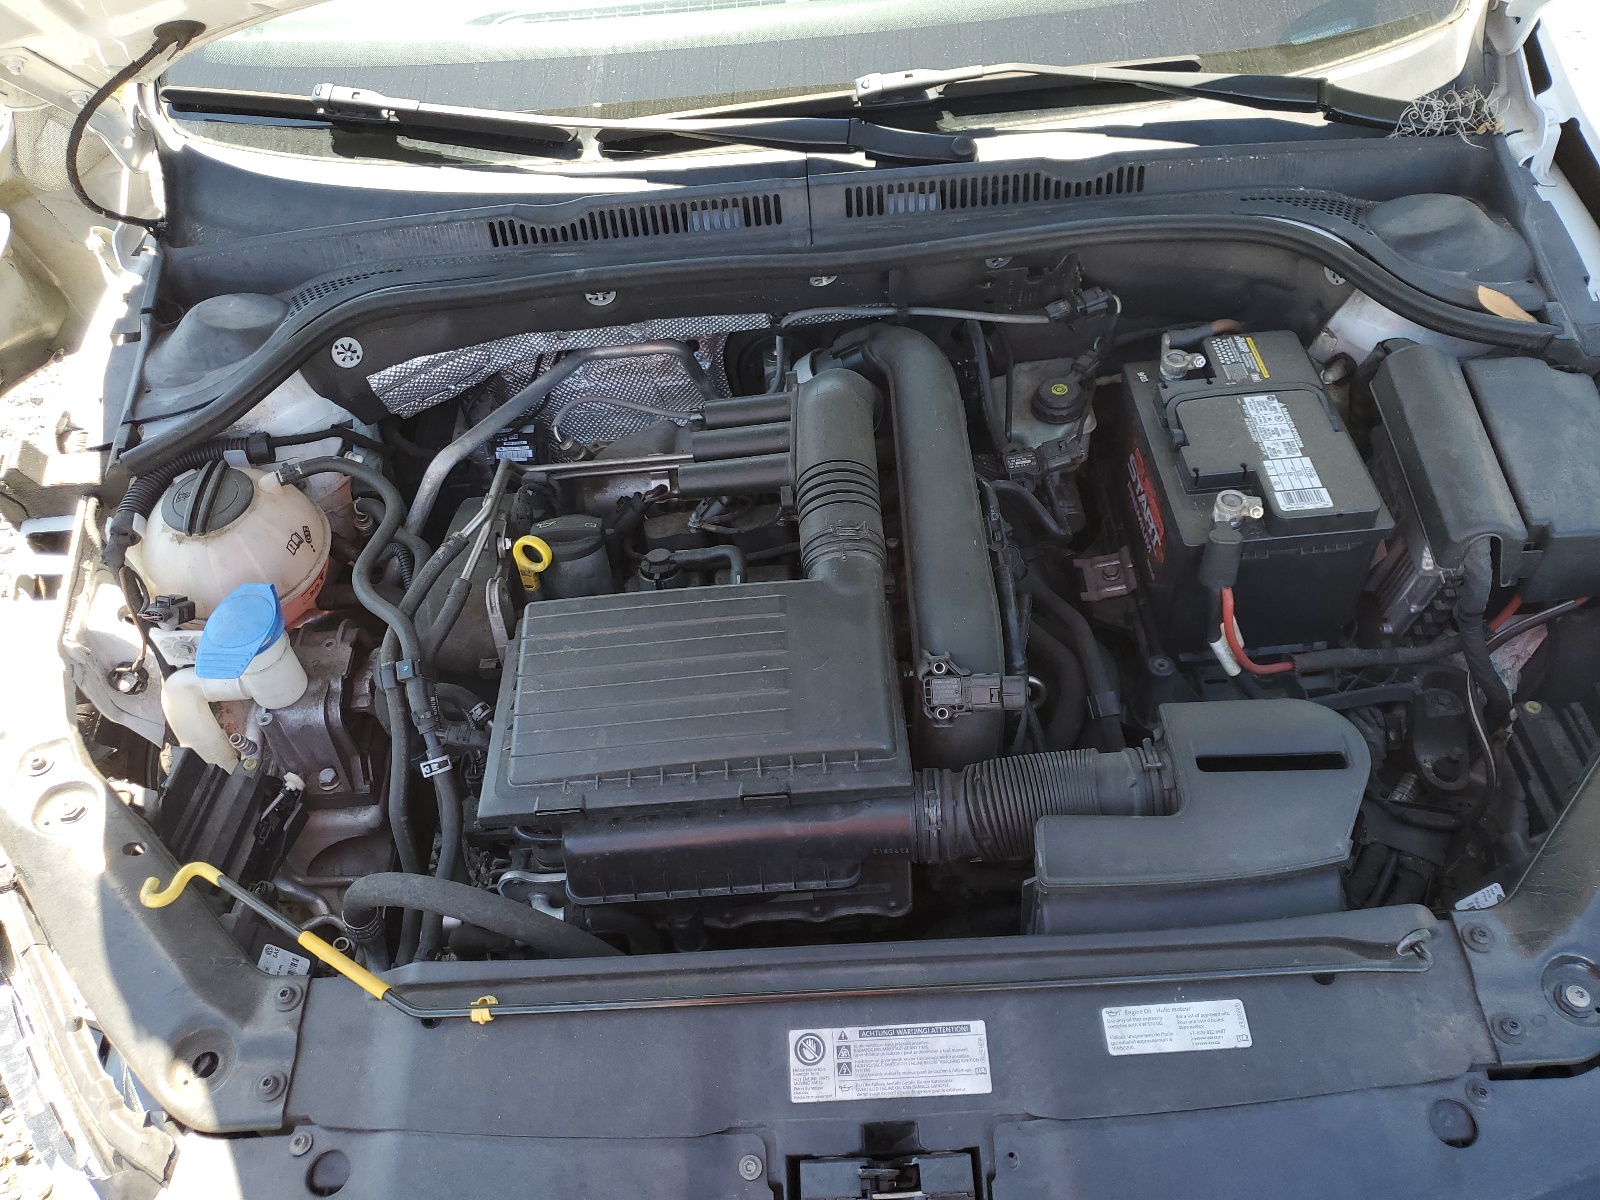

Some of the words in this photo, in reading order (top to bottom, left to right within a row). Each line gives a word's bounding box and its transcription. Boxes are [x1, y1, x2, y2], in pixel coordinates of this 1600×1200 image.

[1128, 453, 1161, 547] START
[861, 1029, 895, 1037] ACHTUNG!
[896, 1027, 930, 1036] WARNING!
[931, 1025, 969, 1034] ATTENTION!
